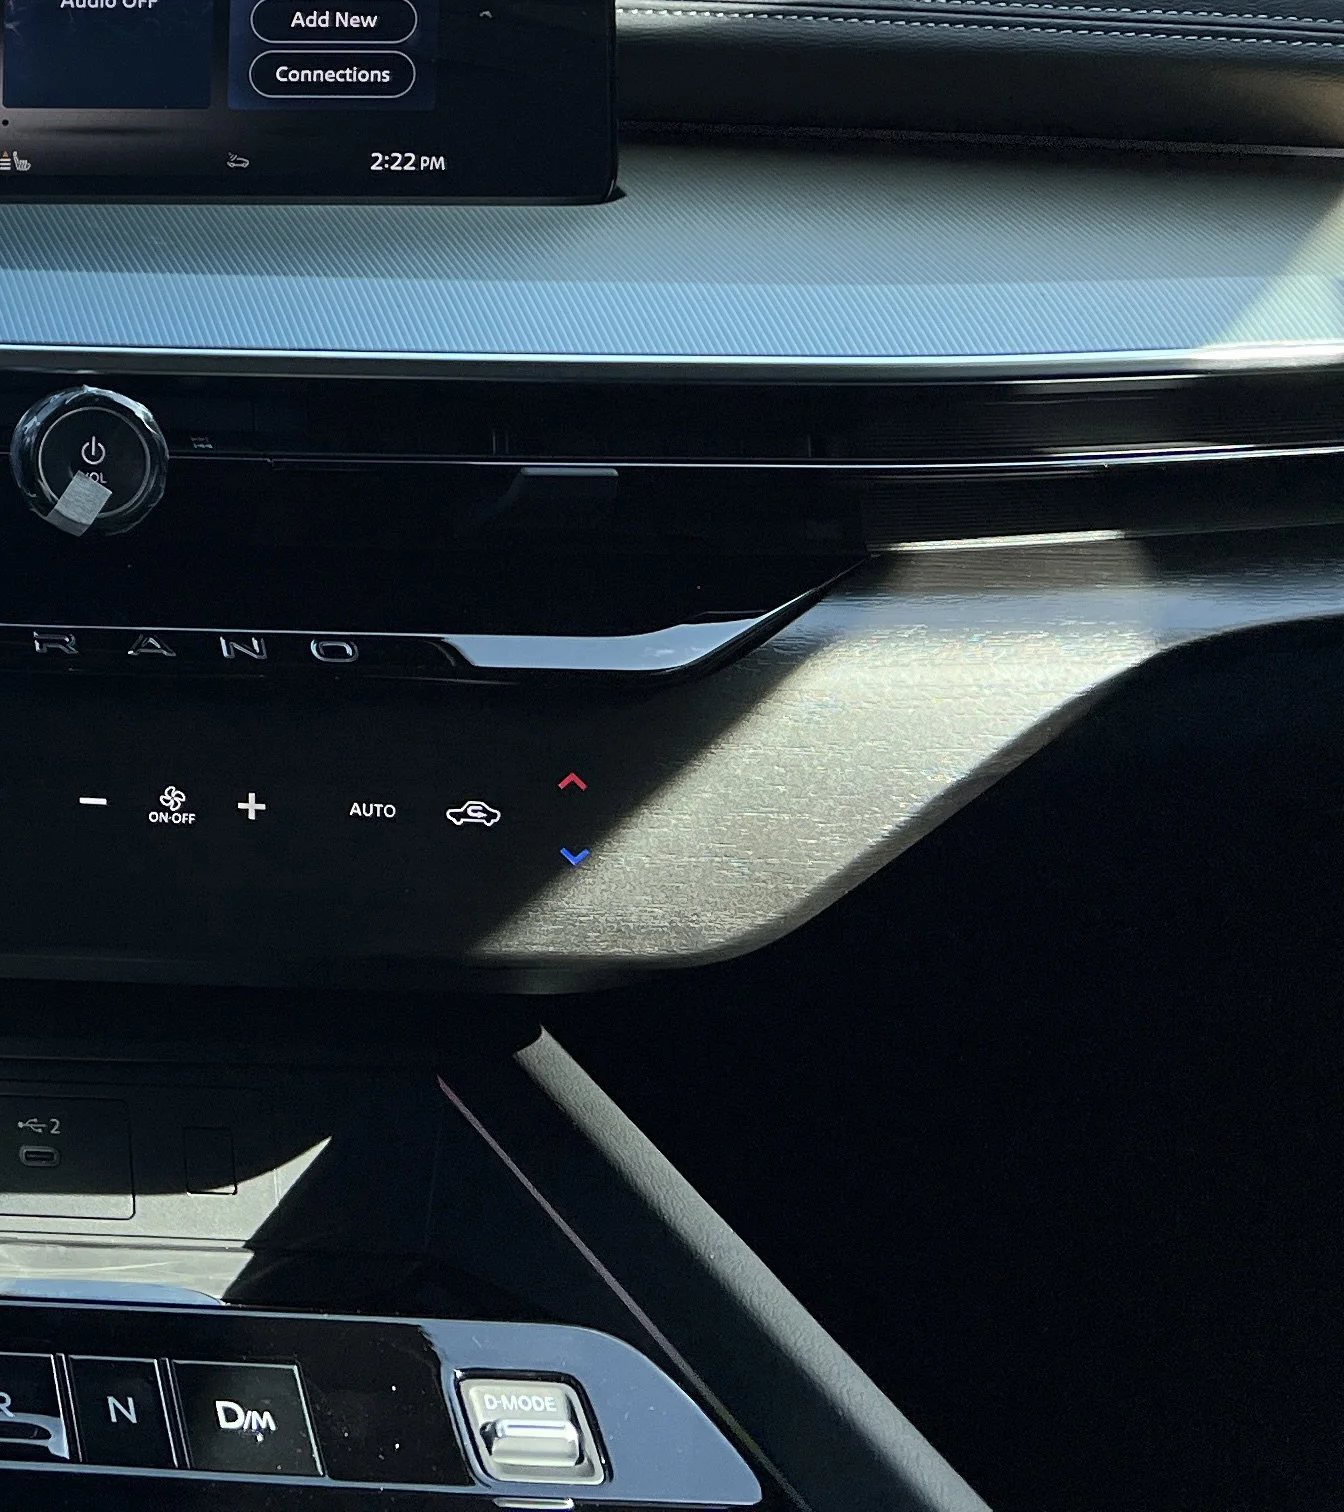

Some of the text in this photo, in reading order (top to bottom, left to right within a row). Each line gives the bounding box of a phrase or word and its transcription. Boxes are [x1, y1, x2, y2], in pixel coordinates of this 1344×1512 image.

[290, 10, 378, 29] Add New
[275, 65, 391, 83] Connections
[370, 152, 446, 171] 2:22 PM
[85, 471, 108, 484] OL
[349, 802, 396, 818] AUTO
[107, 1396, 138, 1424] N
[483, 1394, 557, 1412] D-MODE
[214, 1400, 277, 1431] D/M
